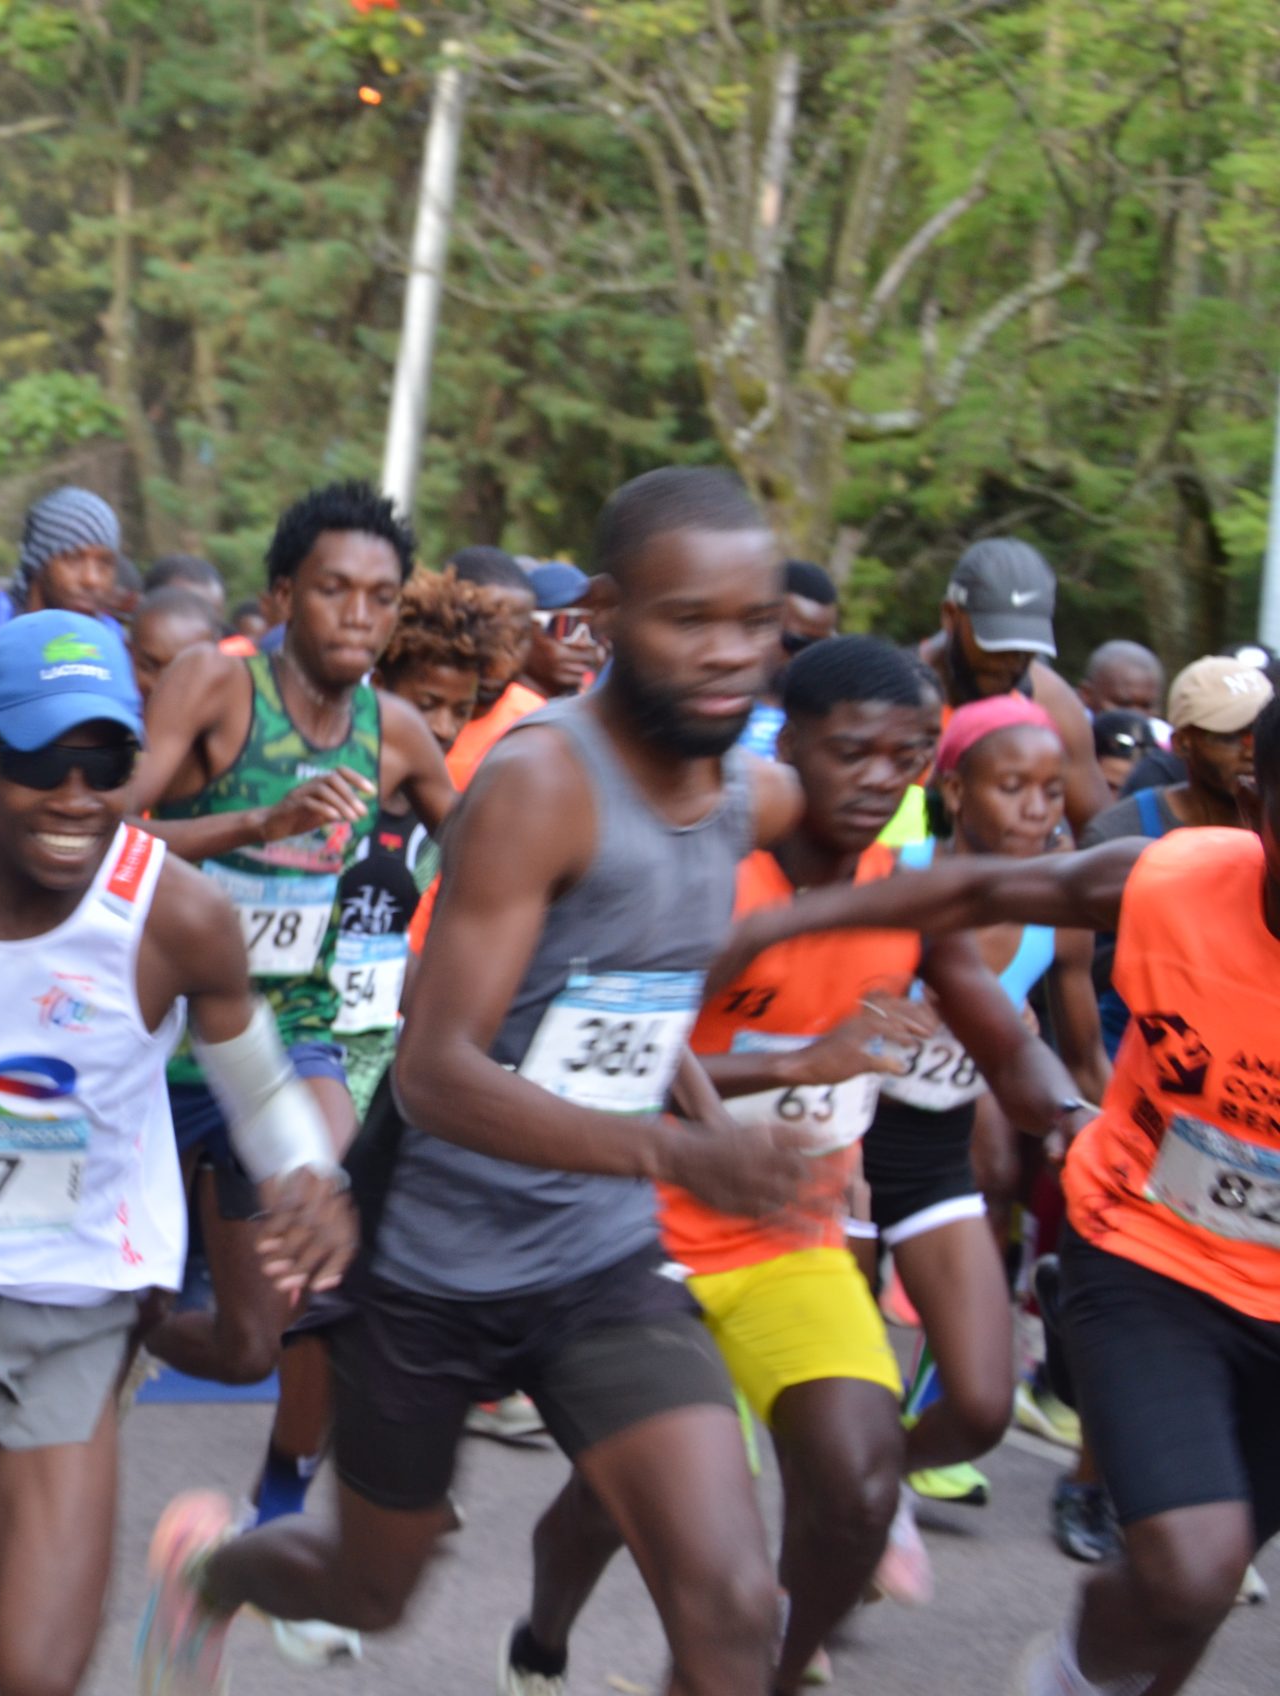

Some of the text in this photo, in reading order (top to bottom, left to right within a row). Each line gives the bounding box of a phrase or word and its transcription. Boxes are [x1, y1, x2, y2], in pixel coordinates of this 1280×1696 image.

[248, 910, 302, 949] 78
[344, 968, 376, 1007] 54
[776, 1084, 836, 1123] 63
